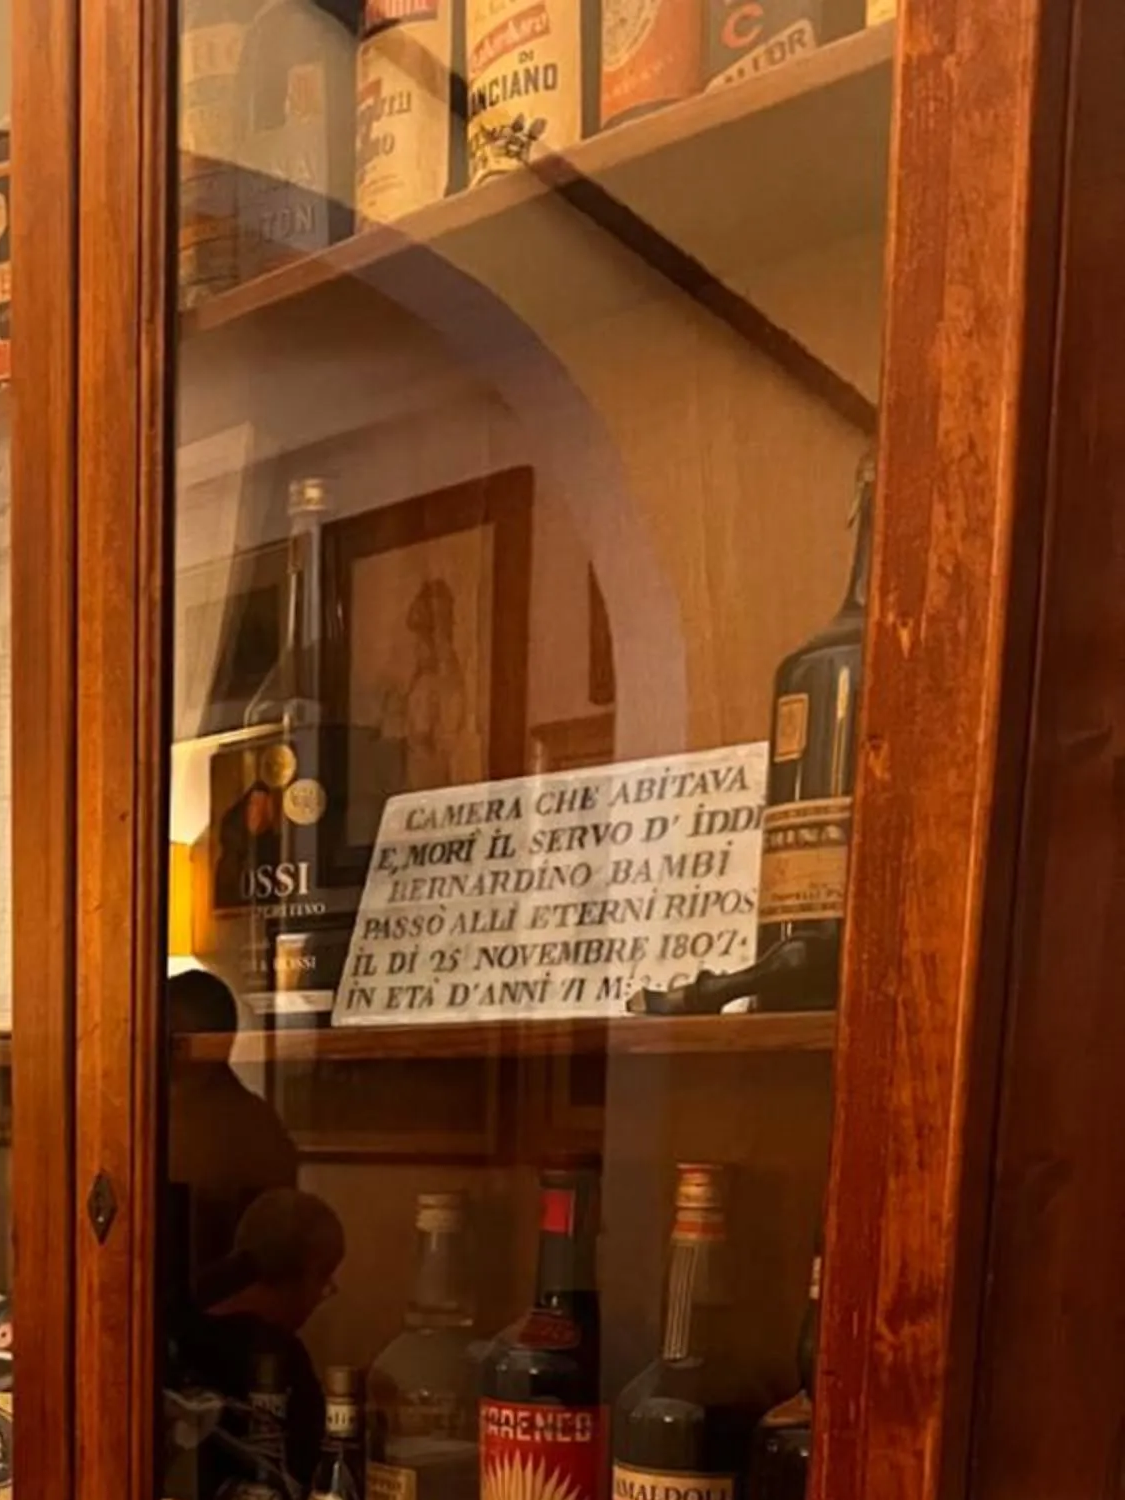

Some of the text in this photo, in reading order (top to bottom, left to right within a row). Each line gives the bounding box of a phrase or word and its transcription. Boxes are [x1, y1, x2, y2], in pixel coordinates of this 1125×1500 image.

[408, 798, 522, 831] CAMERA
[528, 821, 634, 855] SERVO
[240, 861, 309, 899] OSSI
[473, 933, 650, 972] NOVEMBRE
